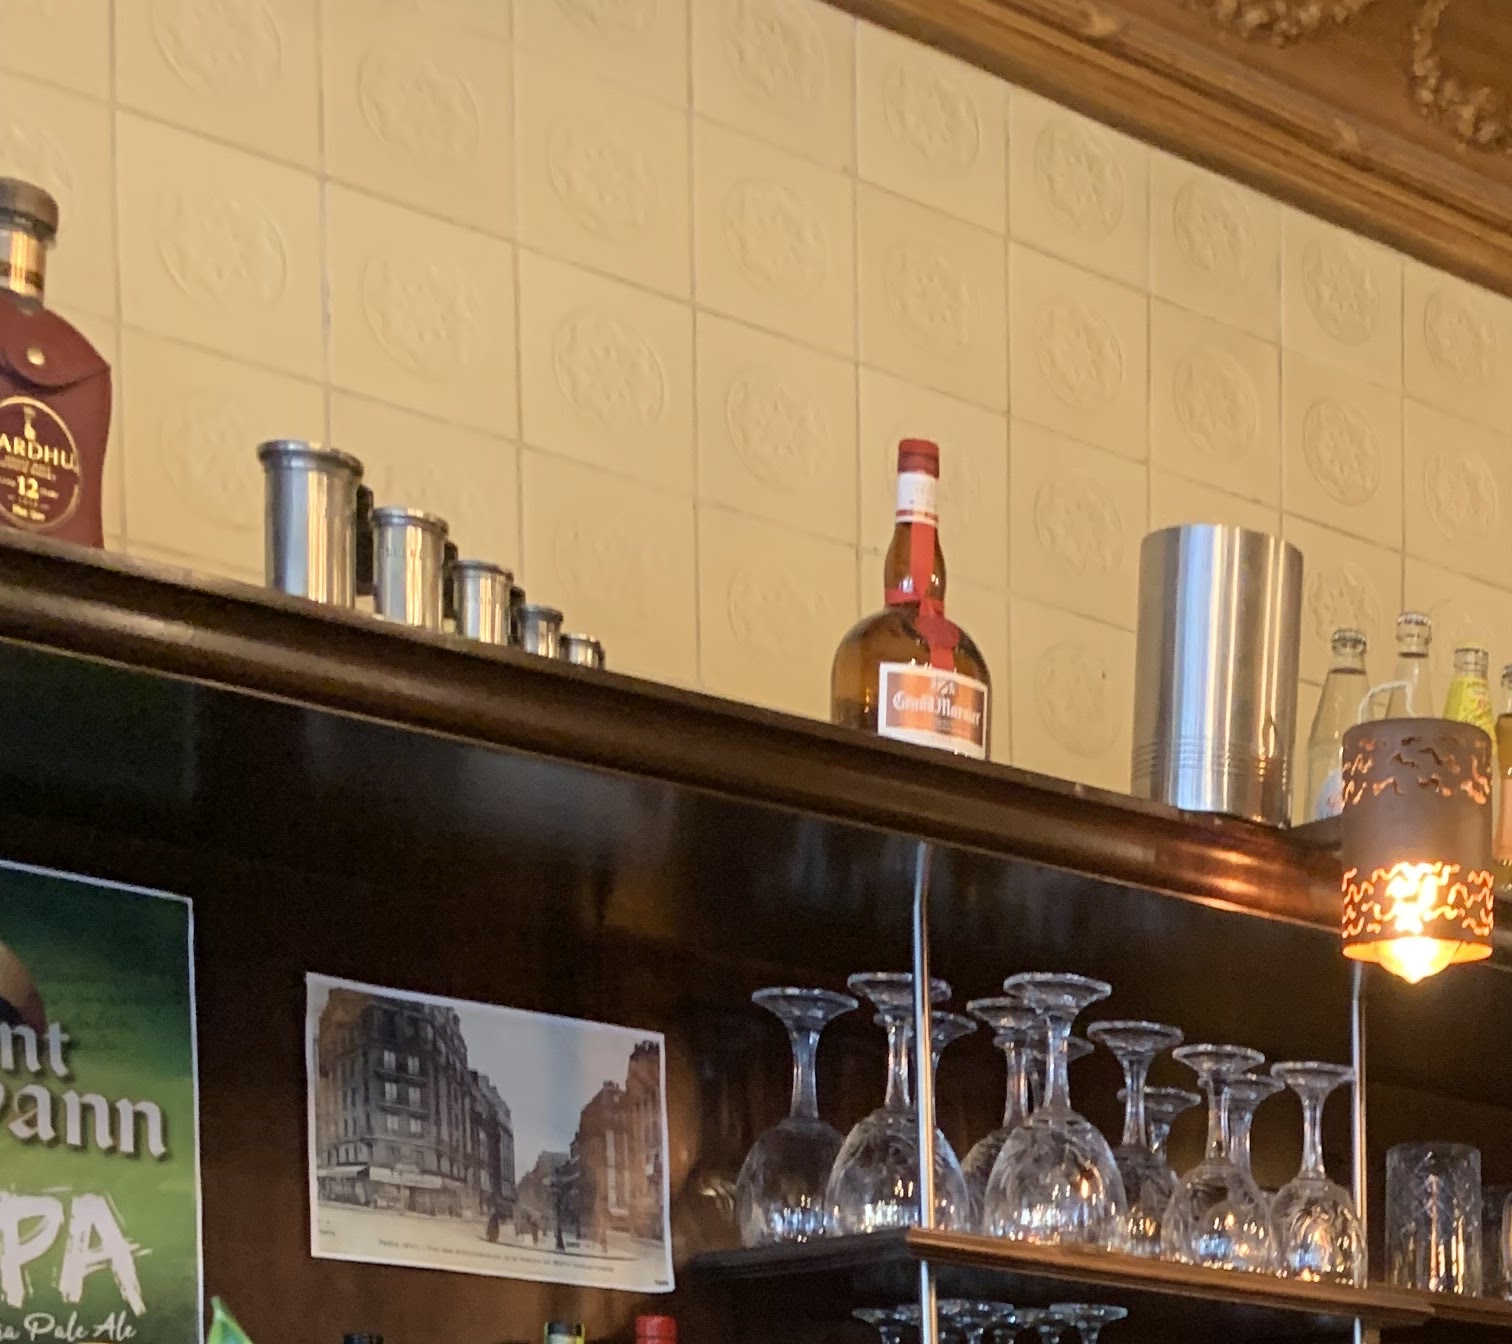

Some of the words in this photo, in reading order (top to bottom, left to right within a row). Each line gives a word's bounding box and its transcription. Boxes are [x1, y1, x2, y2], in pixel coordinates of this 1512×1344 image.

[17, 475, 40, 499] 12
[0, 1084, 166, 1157] ann
[24, 1312, 88, 1342] Pale
[92, 1310, 137, 1340] Ale
